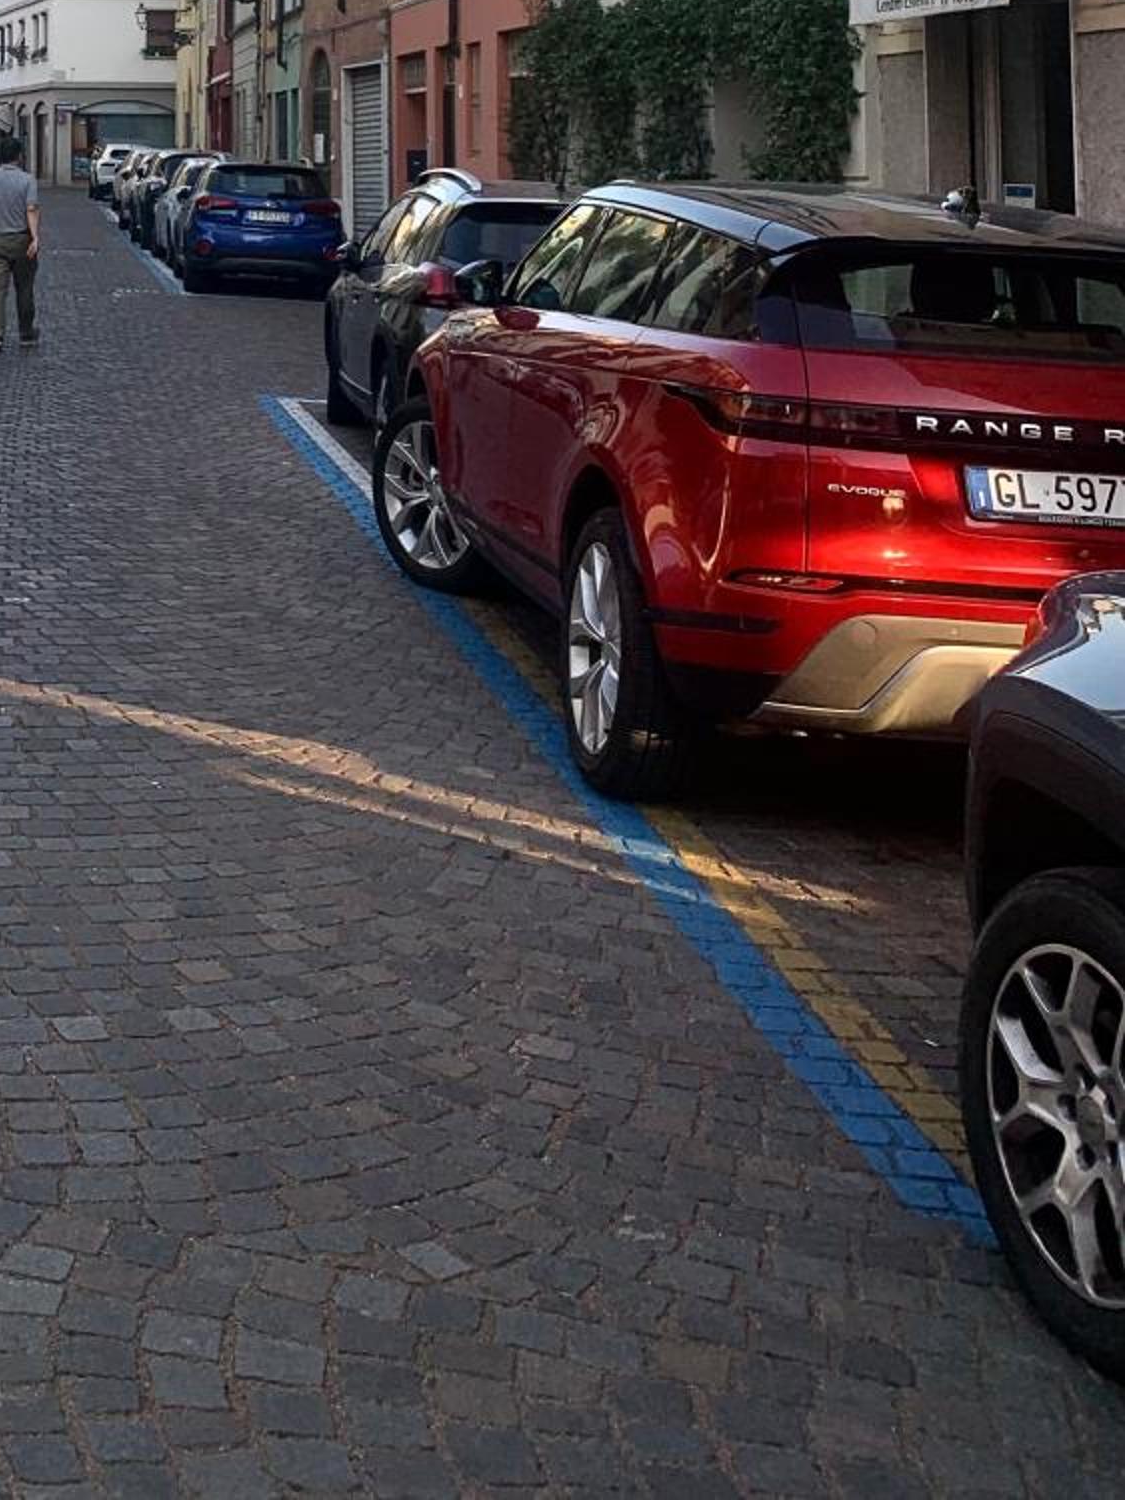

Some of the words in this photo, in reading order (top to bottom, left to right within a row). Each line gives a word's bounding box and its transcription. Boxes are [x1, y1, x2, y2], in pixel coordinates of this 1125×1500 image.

[916, 415, 1074, 442] RANGE
[827, 483, 907, 498] EVOQUE
[994, 472, 1041, 509] GL
[1054, 475, 1125, 514] 597
